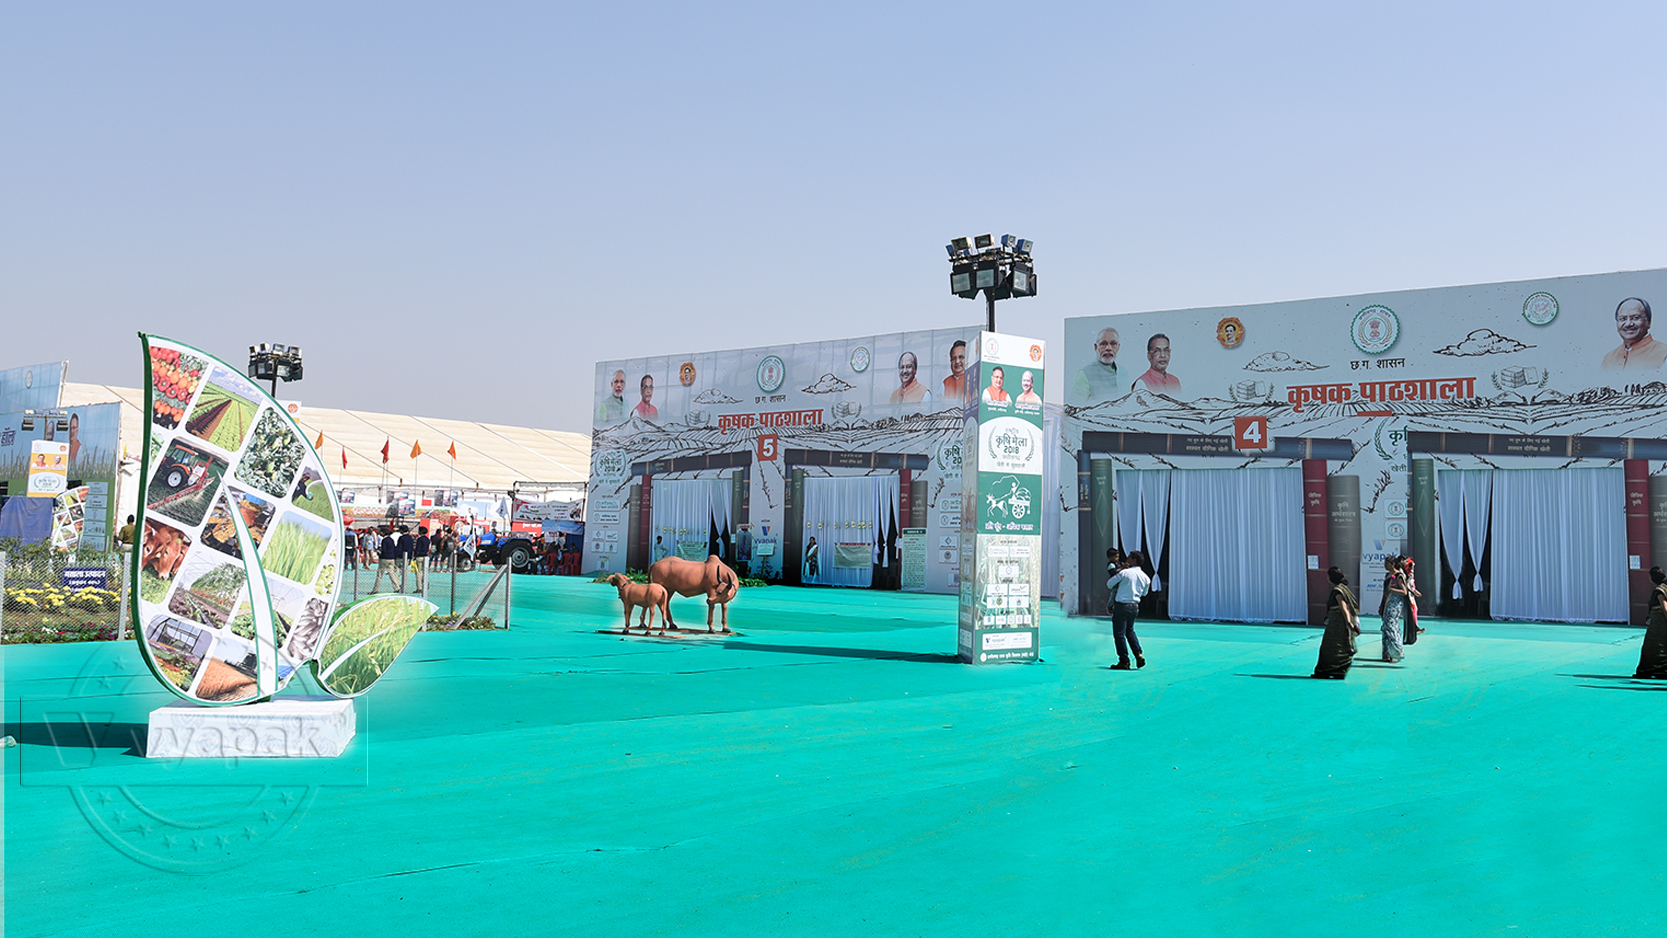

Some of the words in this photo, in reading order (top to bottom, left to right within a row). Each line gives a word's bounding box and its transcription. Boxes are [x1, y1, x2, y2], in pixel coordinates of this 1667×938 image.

[1376, 358, 1405, 369] शासन
[1286, 382, 1353, 413] कृषक
[1358, 376, 1477, 405] पाठशाला
[718, 413, 756, 435] कृषक
[759, 408, 824, 428] पाठशाला
[1011, 434, 1028, 448] मेला
[1243, 421, 1261, 443] 4
[763, 438, 774, 457] 5
[1337, 500, 1349, 510] कृषि
